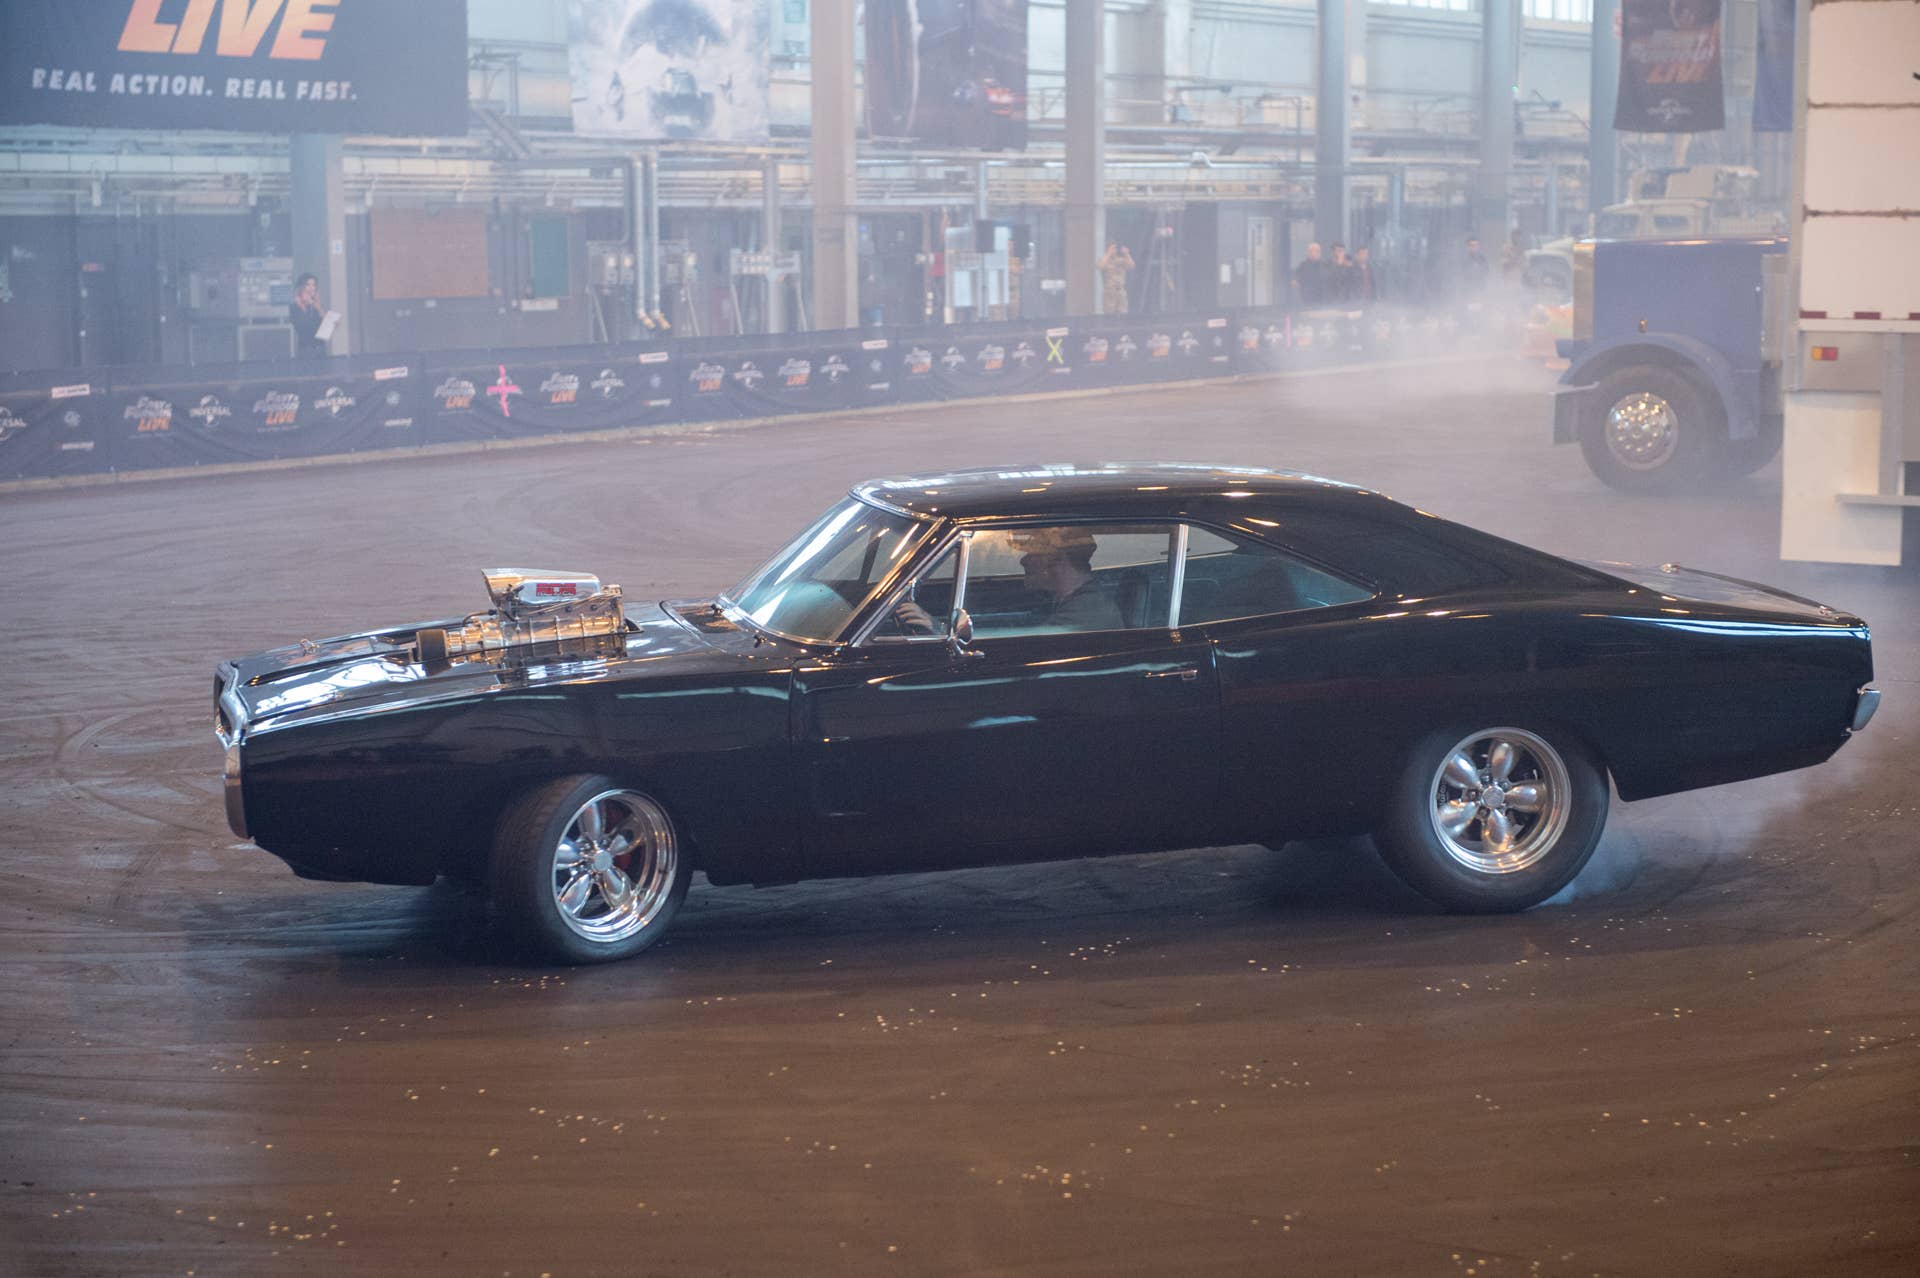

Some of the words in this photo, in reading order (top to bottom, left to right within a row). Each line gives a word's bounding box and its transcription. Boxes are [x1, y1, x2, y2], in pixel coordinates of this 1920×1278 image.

[117, 0, 341, 60] LIVE
[32, 68, 97, 93] REAL
[109, 73, 213, 97] ACTION.
[225, 77, 286, 101] REAL
[296, 80, 357, 102] FAST.
